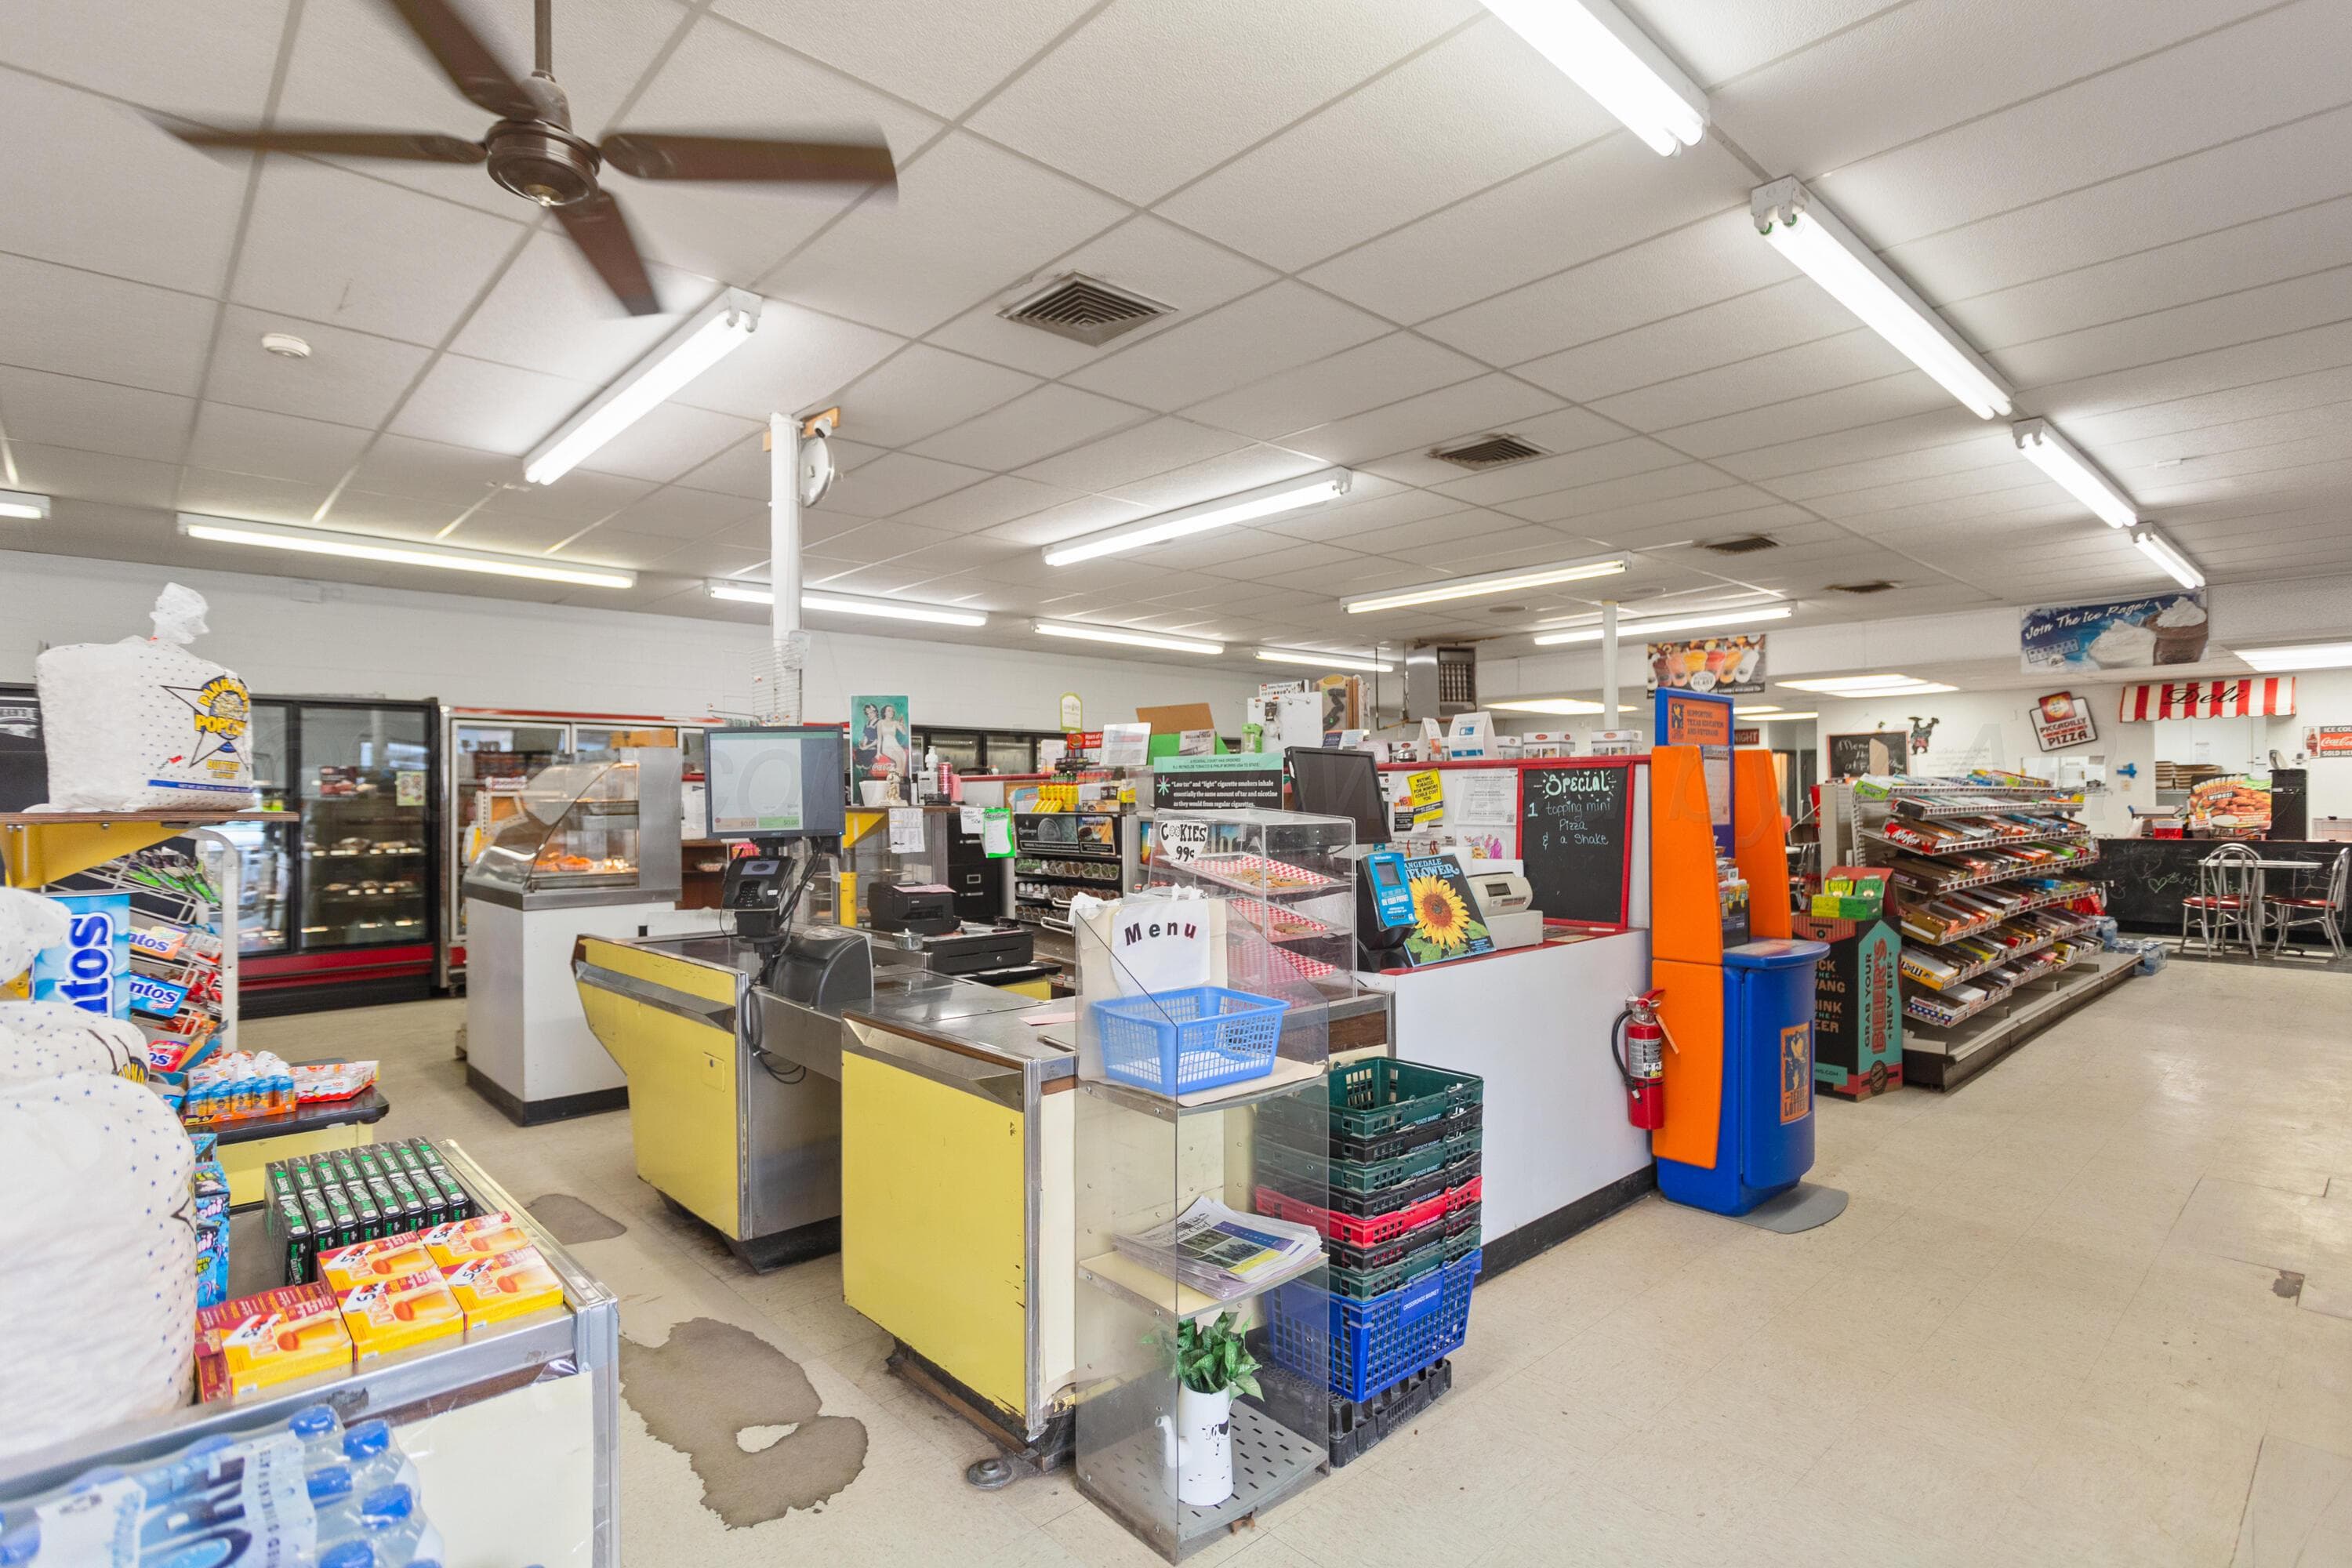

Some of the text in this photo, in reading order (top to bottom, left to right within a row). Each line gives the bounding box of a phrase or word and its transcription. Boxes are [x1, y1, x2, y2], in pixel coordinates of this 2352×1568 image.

[2025, 622, 2053, 640] Join
[2056, 613, 2081, 628] The
[2082, 611, 2103, 623] Ice
[2162, 685, 2247, 705] Deli
[2039, 717, 2087, 733] PICCADILLY
[2047, 730, 2089, 747] PIZZA
[2193, 774, 2246, 793] BONELESS
[1527, 797, 1610, 822] 1 topping mini
[1161, 823, 1207, 841] COOKIES
[1559, 818, 1588, 831] Pizza
[1574, 833, 1609, 845] Shake
[1404, 858, 1442, 869] ANGEDALE
[1406, 863, 1460, 880] FLOWER
[129, 932, 169, 952] ntos
[1124, 922, 1196, 946] Menu
[129, 981, 179, 1004] ntos
[1815, 979, 1846, 993] ANG
[1815, 1019, 1839, 1033] EER
[1189, 1221, 1211, 1236] Chief
[1403, 1289, 1439, 1311] CROSSROADS MARKET
